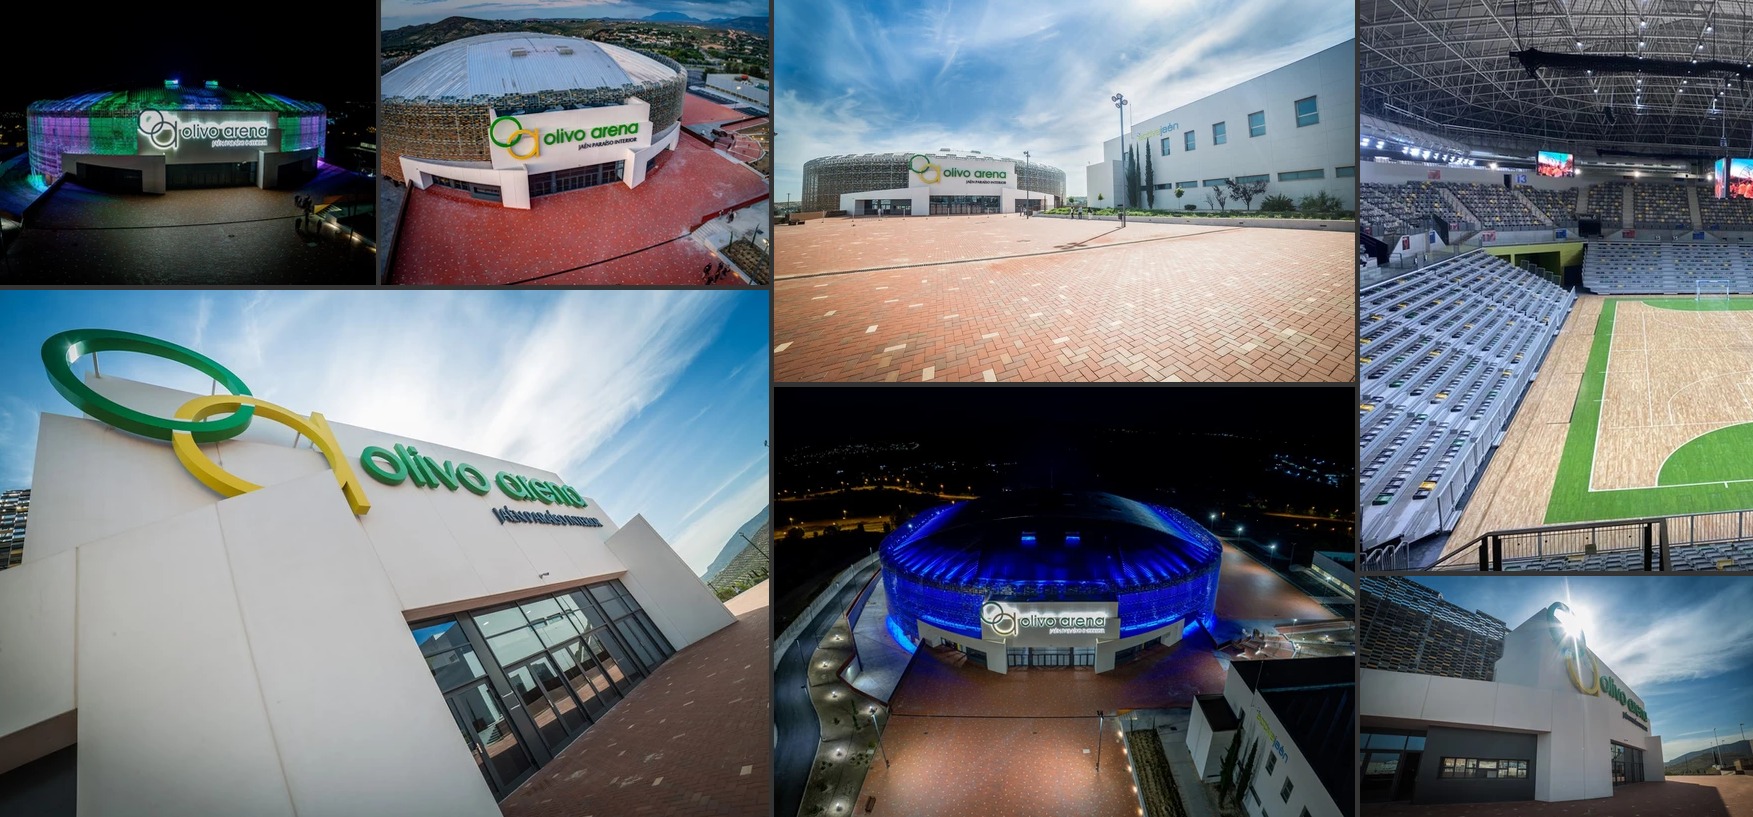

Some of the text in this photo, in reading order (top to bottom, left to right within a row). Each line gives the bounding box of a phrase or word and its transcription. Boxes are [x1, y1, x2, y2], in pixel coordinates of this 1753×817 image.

[181, 124, 268, 139] olivo arena
[543, 122, 639, 146] olivo arena
[578, 137, 637, 151] JAÉN PARAÍSO INTERIOR
[943, 167, 1007, 179] olivo arena
[359, 442, 588, 508] olivo arena
[1021, 614, 1106, 628] olivo arena
[1599, 675, 1627, 706] olivo
[1627, 698, 1648, 722] arena
